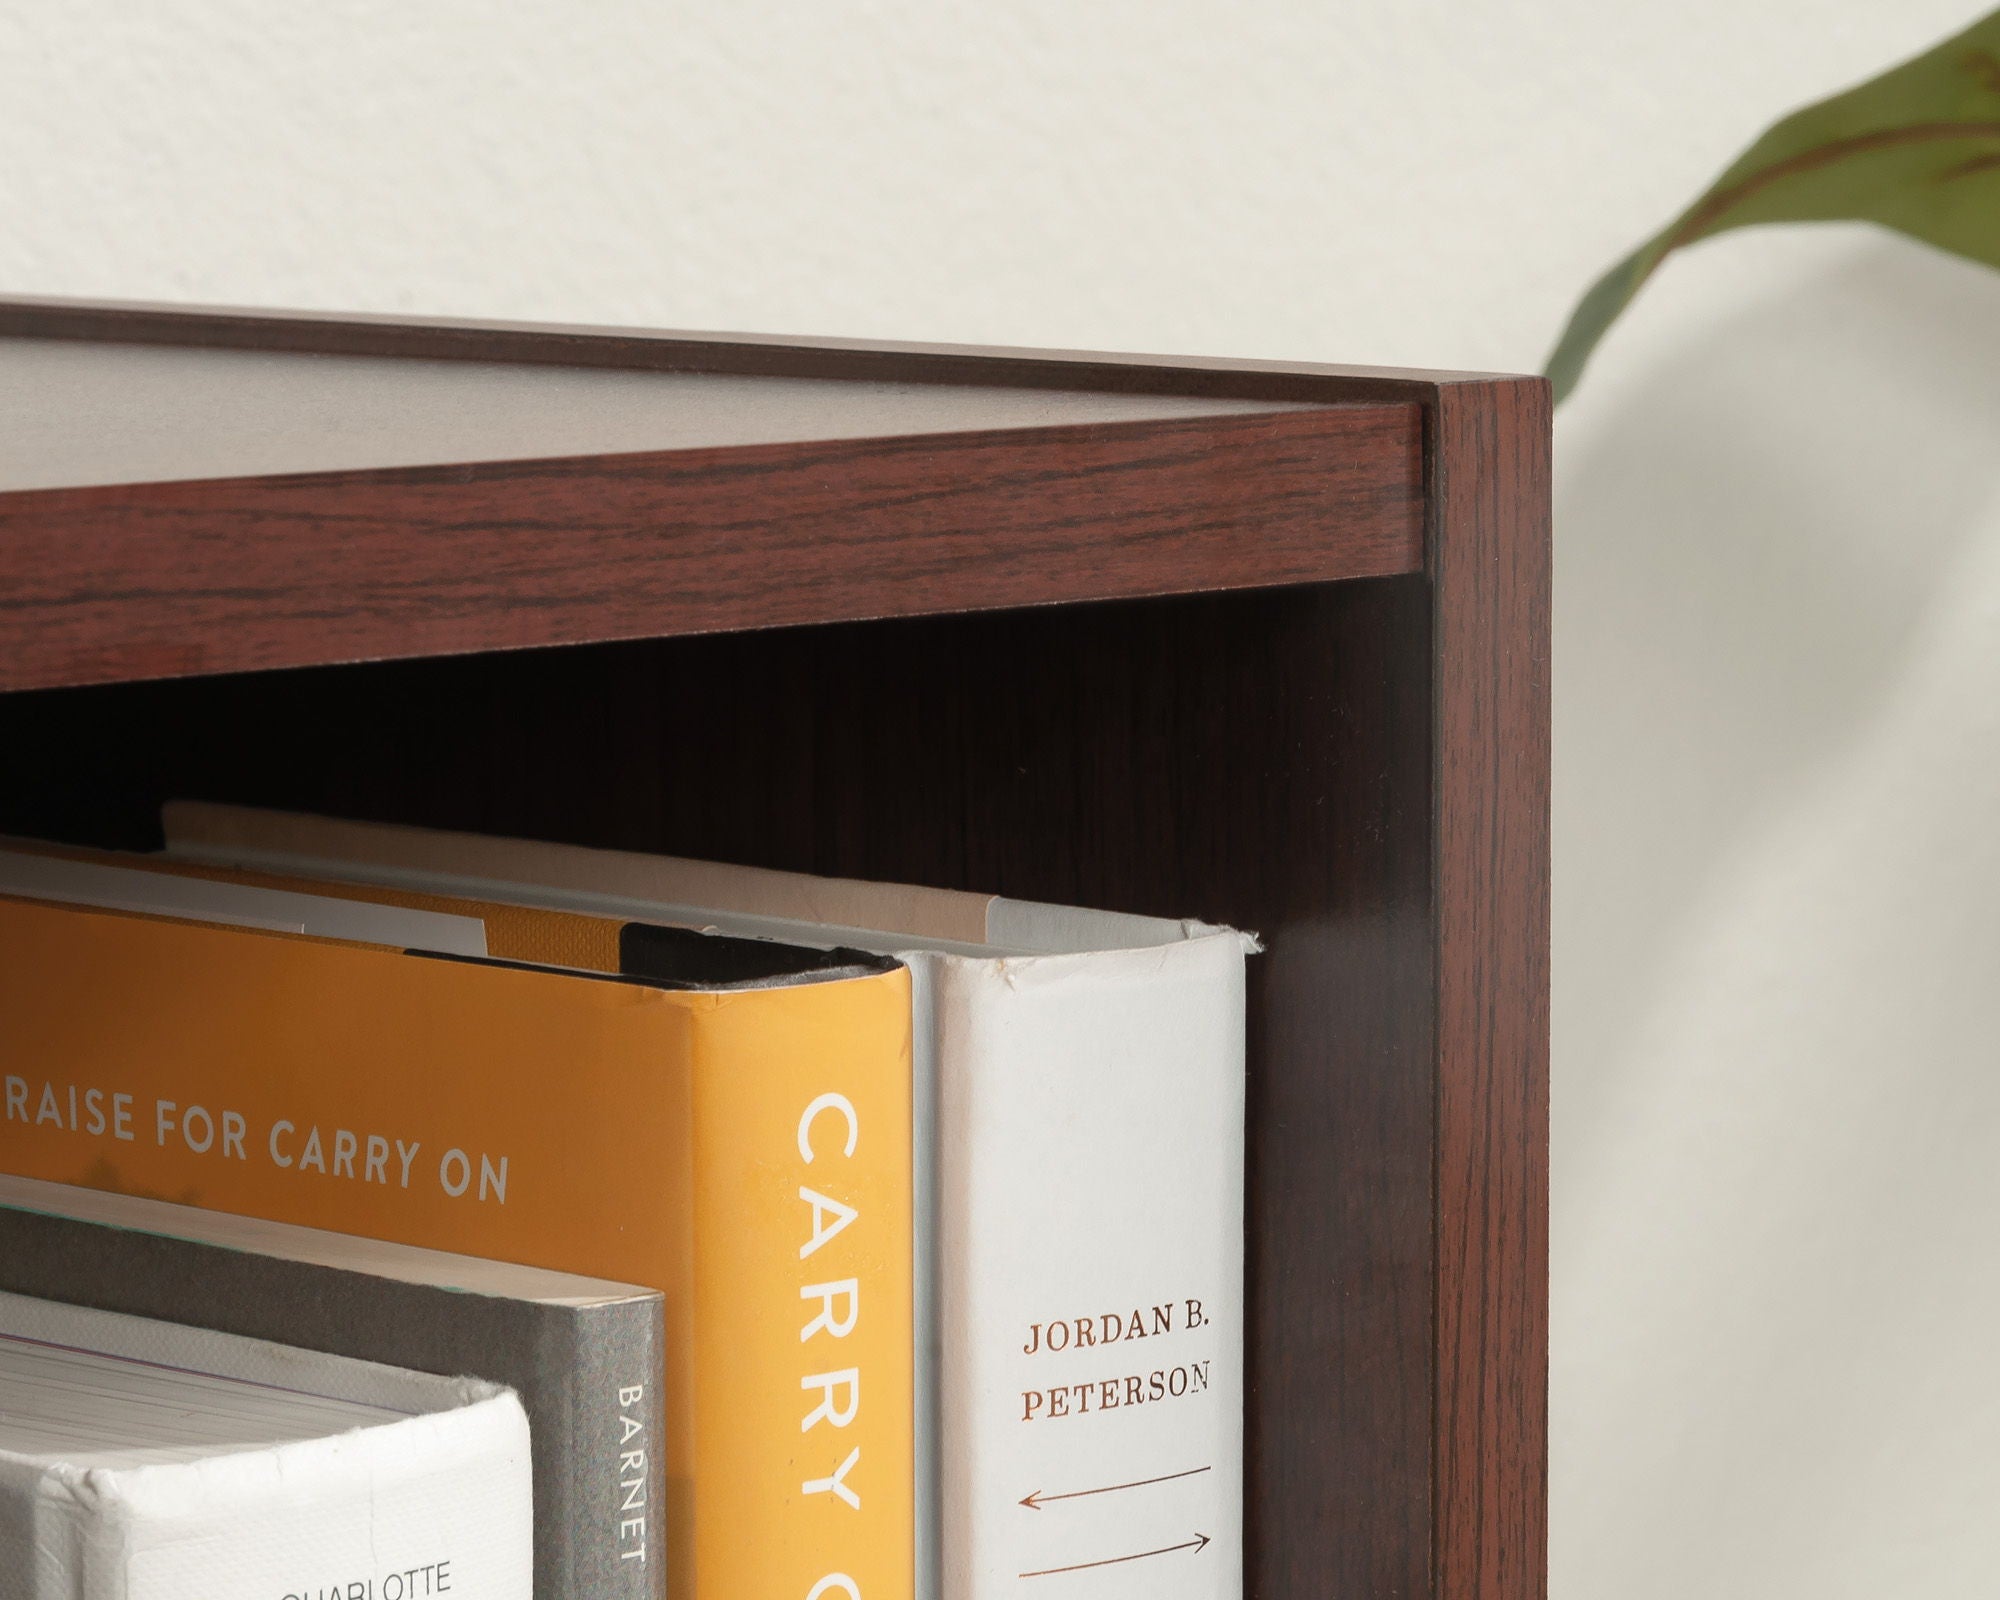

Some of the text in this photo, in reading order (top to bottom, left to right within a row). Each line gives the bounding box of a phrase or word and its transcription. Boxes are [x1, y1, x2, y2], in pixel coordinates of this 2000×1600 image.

[5, 1075, 509, 1205] RAISE FOR CARRY ON
[797, 1092, 860, 1510] CARRY
[1023, 1299, 1210, 1355] JORDAN B.
[1021, 1360, 1211, 1422] PETERSON
[617, 1384, 647, 1563] BARNET
[281, 1561, 451, 1600] RLOTTE
